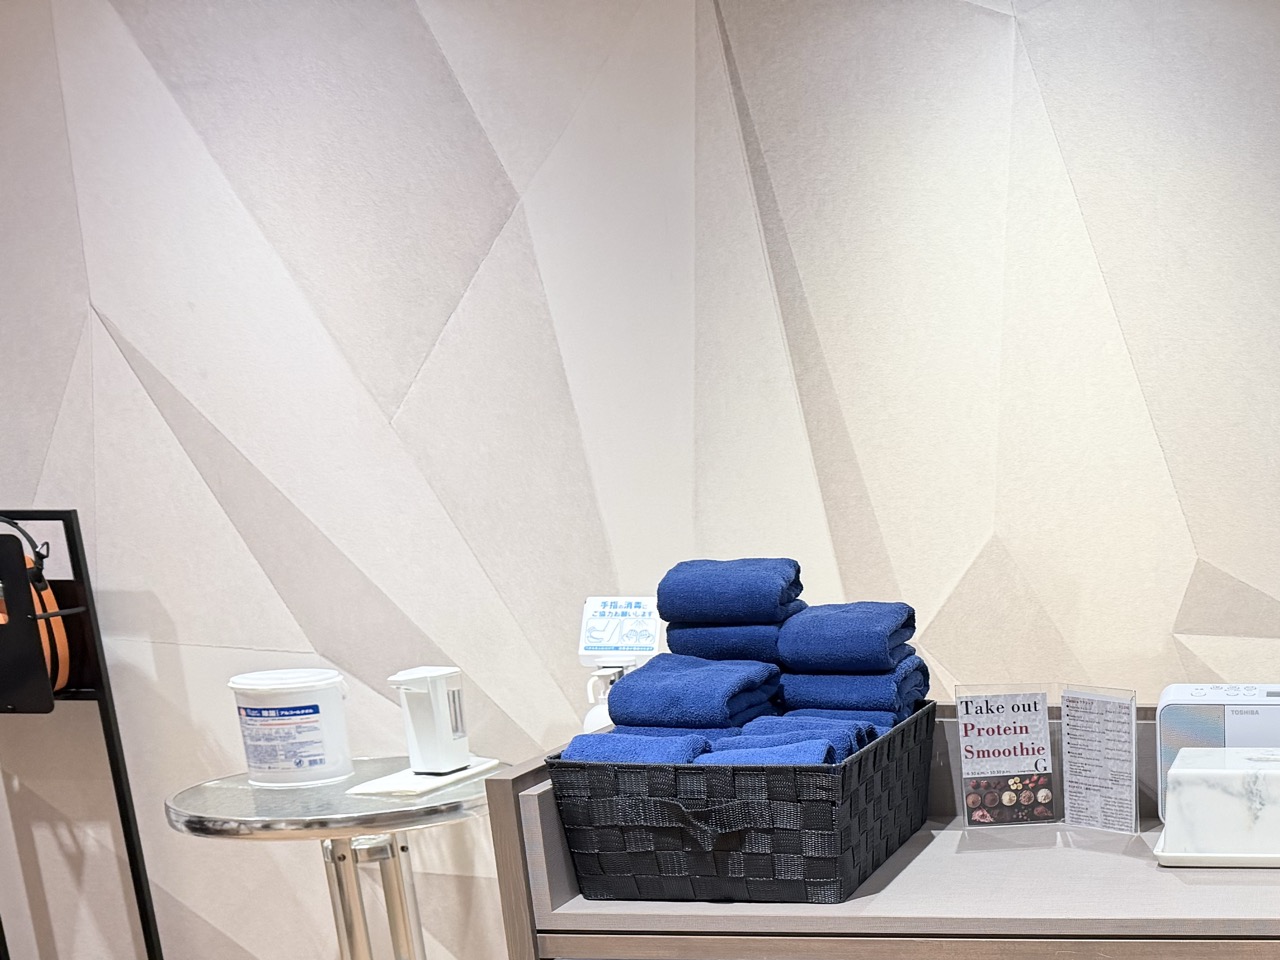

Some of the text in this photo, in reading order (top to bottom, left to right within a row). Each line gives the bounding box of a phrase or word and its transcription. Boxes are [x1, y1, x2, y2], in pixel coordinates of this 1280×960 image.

[961, 700, 1040, 716] Take out
[962, 721, 1029, 737] Protein
[964, 742, 1045, 759] Smoothie
[1034, 758, 1047, 772] G
